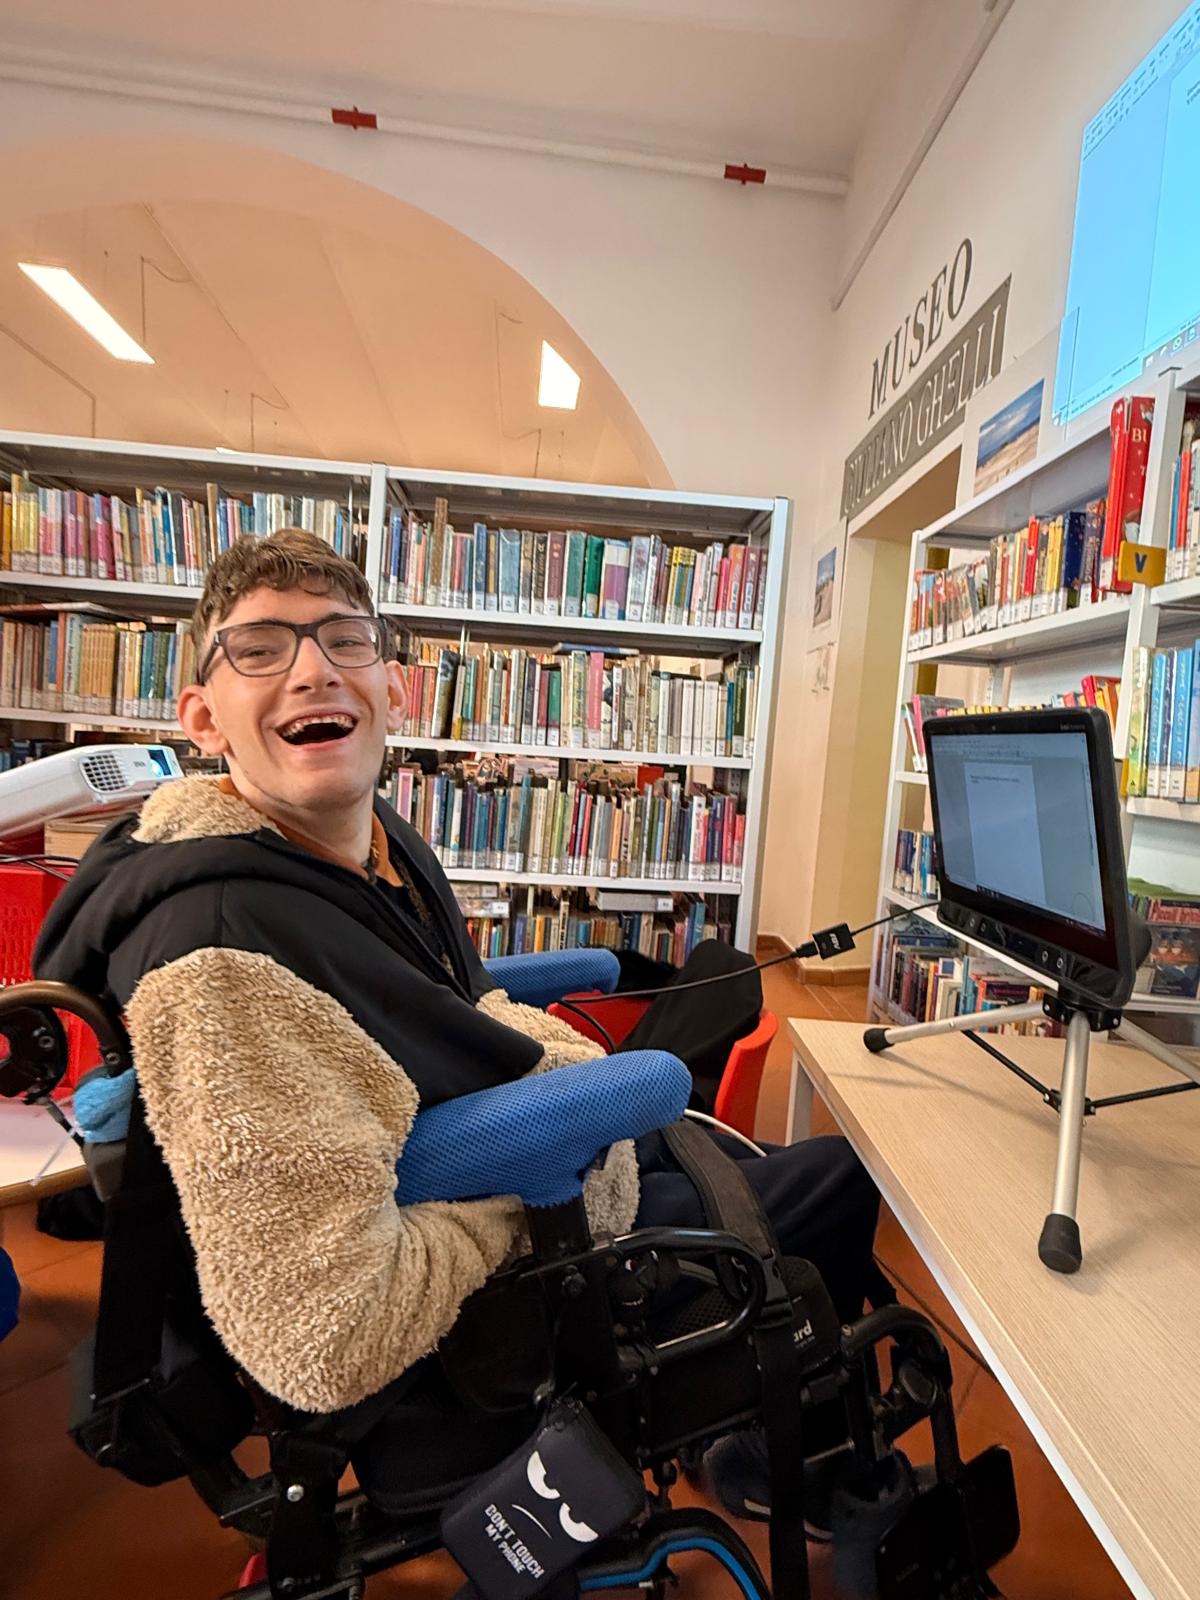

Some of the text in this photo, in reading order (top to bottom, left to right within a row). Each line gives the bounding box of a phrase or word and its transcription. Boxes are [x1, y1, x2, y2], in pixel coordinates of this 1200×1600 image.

[868, 238, 972, 420] MUSEO
[916, 304, 1001, 446] GHELLI
[1134, 551, 1148, 573] V
[485, 1504, 545, 1579] DON'T TOUCH
[485, 1524, 526, 1574] MY PHONE
